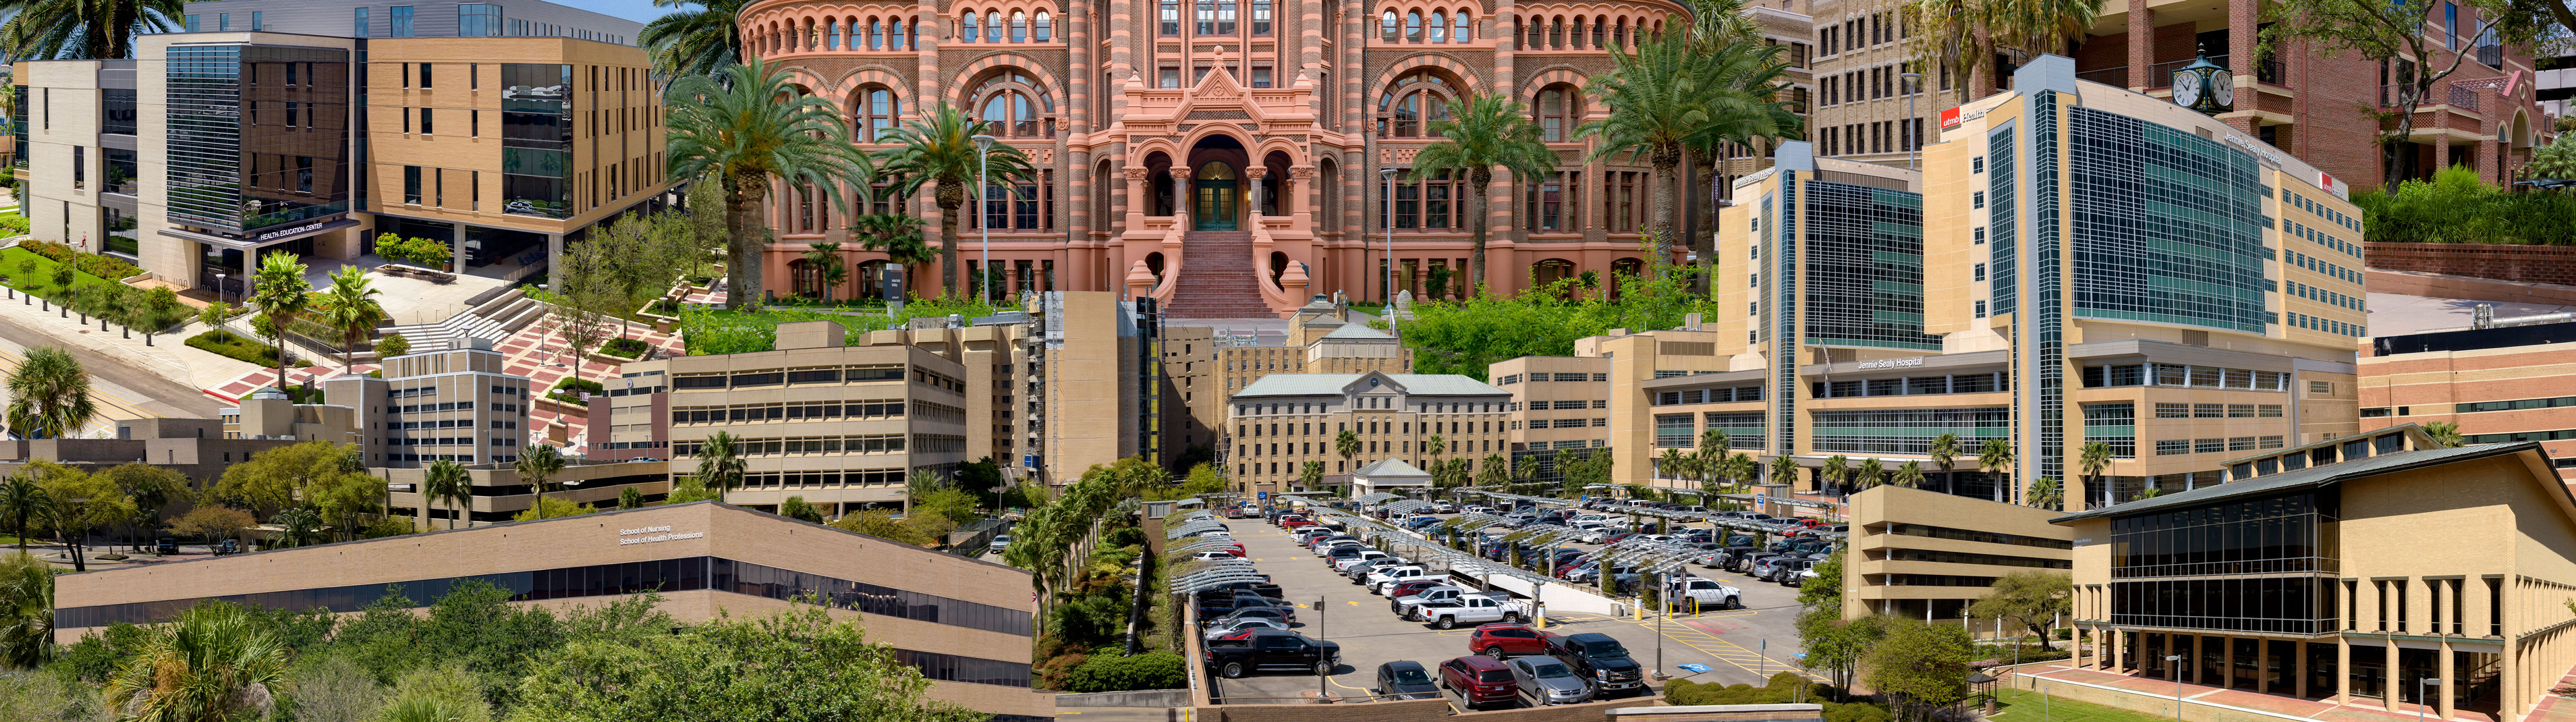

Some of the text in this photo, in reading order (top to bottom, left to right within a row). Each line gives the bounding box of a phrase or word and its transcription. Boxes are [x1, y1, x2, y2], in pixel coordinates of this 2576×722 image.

[1943, 108, 1984, 126] utmb Health
[2223, 131, 2282, 165] Jennie Sealy Hospital
[1735, 179, 1748, 188] Jennie
[1749, 173, 1760, 183] Sealy
[260, 223, 322, 240] HEALTH EDUCATION CENTER
[1859, 357, 1922, 369] Jennie Sealy Hospital
[620, 528, 639, 536] School
[648, 525, 670, 533] Nursing
[620, 537, 639, 545] School
[648, 534, 667, 543] Health
[668, 531, 703, 540] Professions
